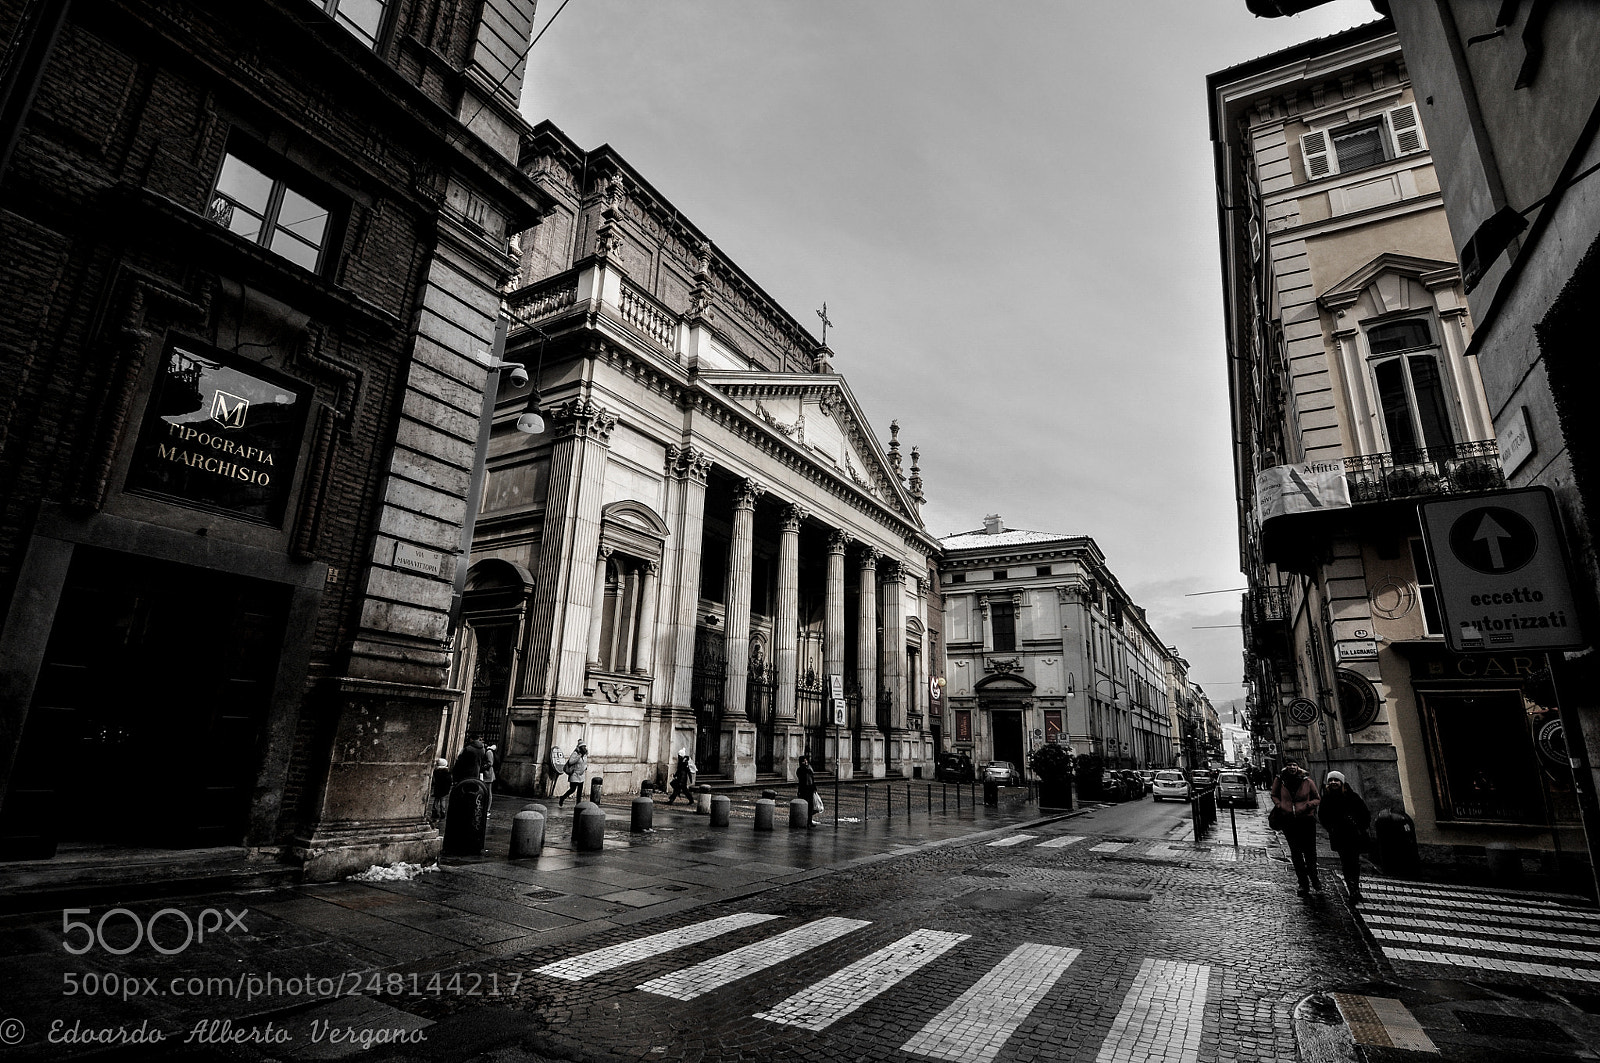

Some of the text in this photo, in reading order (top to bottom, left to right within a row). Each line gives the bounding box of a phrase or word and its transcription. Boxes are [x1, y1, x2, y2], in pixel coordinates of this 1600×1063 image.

[214, 395, 246, 426] M
[169, 422, 274, 466] TIPOGRAFIA
[157, 442, 270, 487] MARCHISIO
[1303, 463, 1340, 475] Affitta
[1471, 587, 1543, 606] eccetto
[1350, 648, 1377, 656] LAGRANGE
